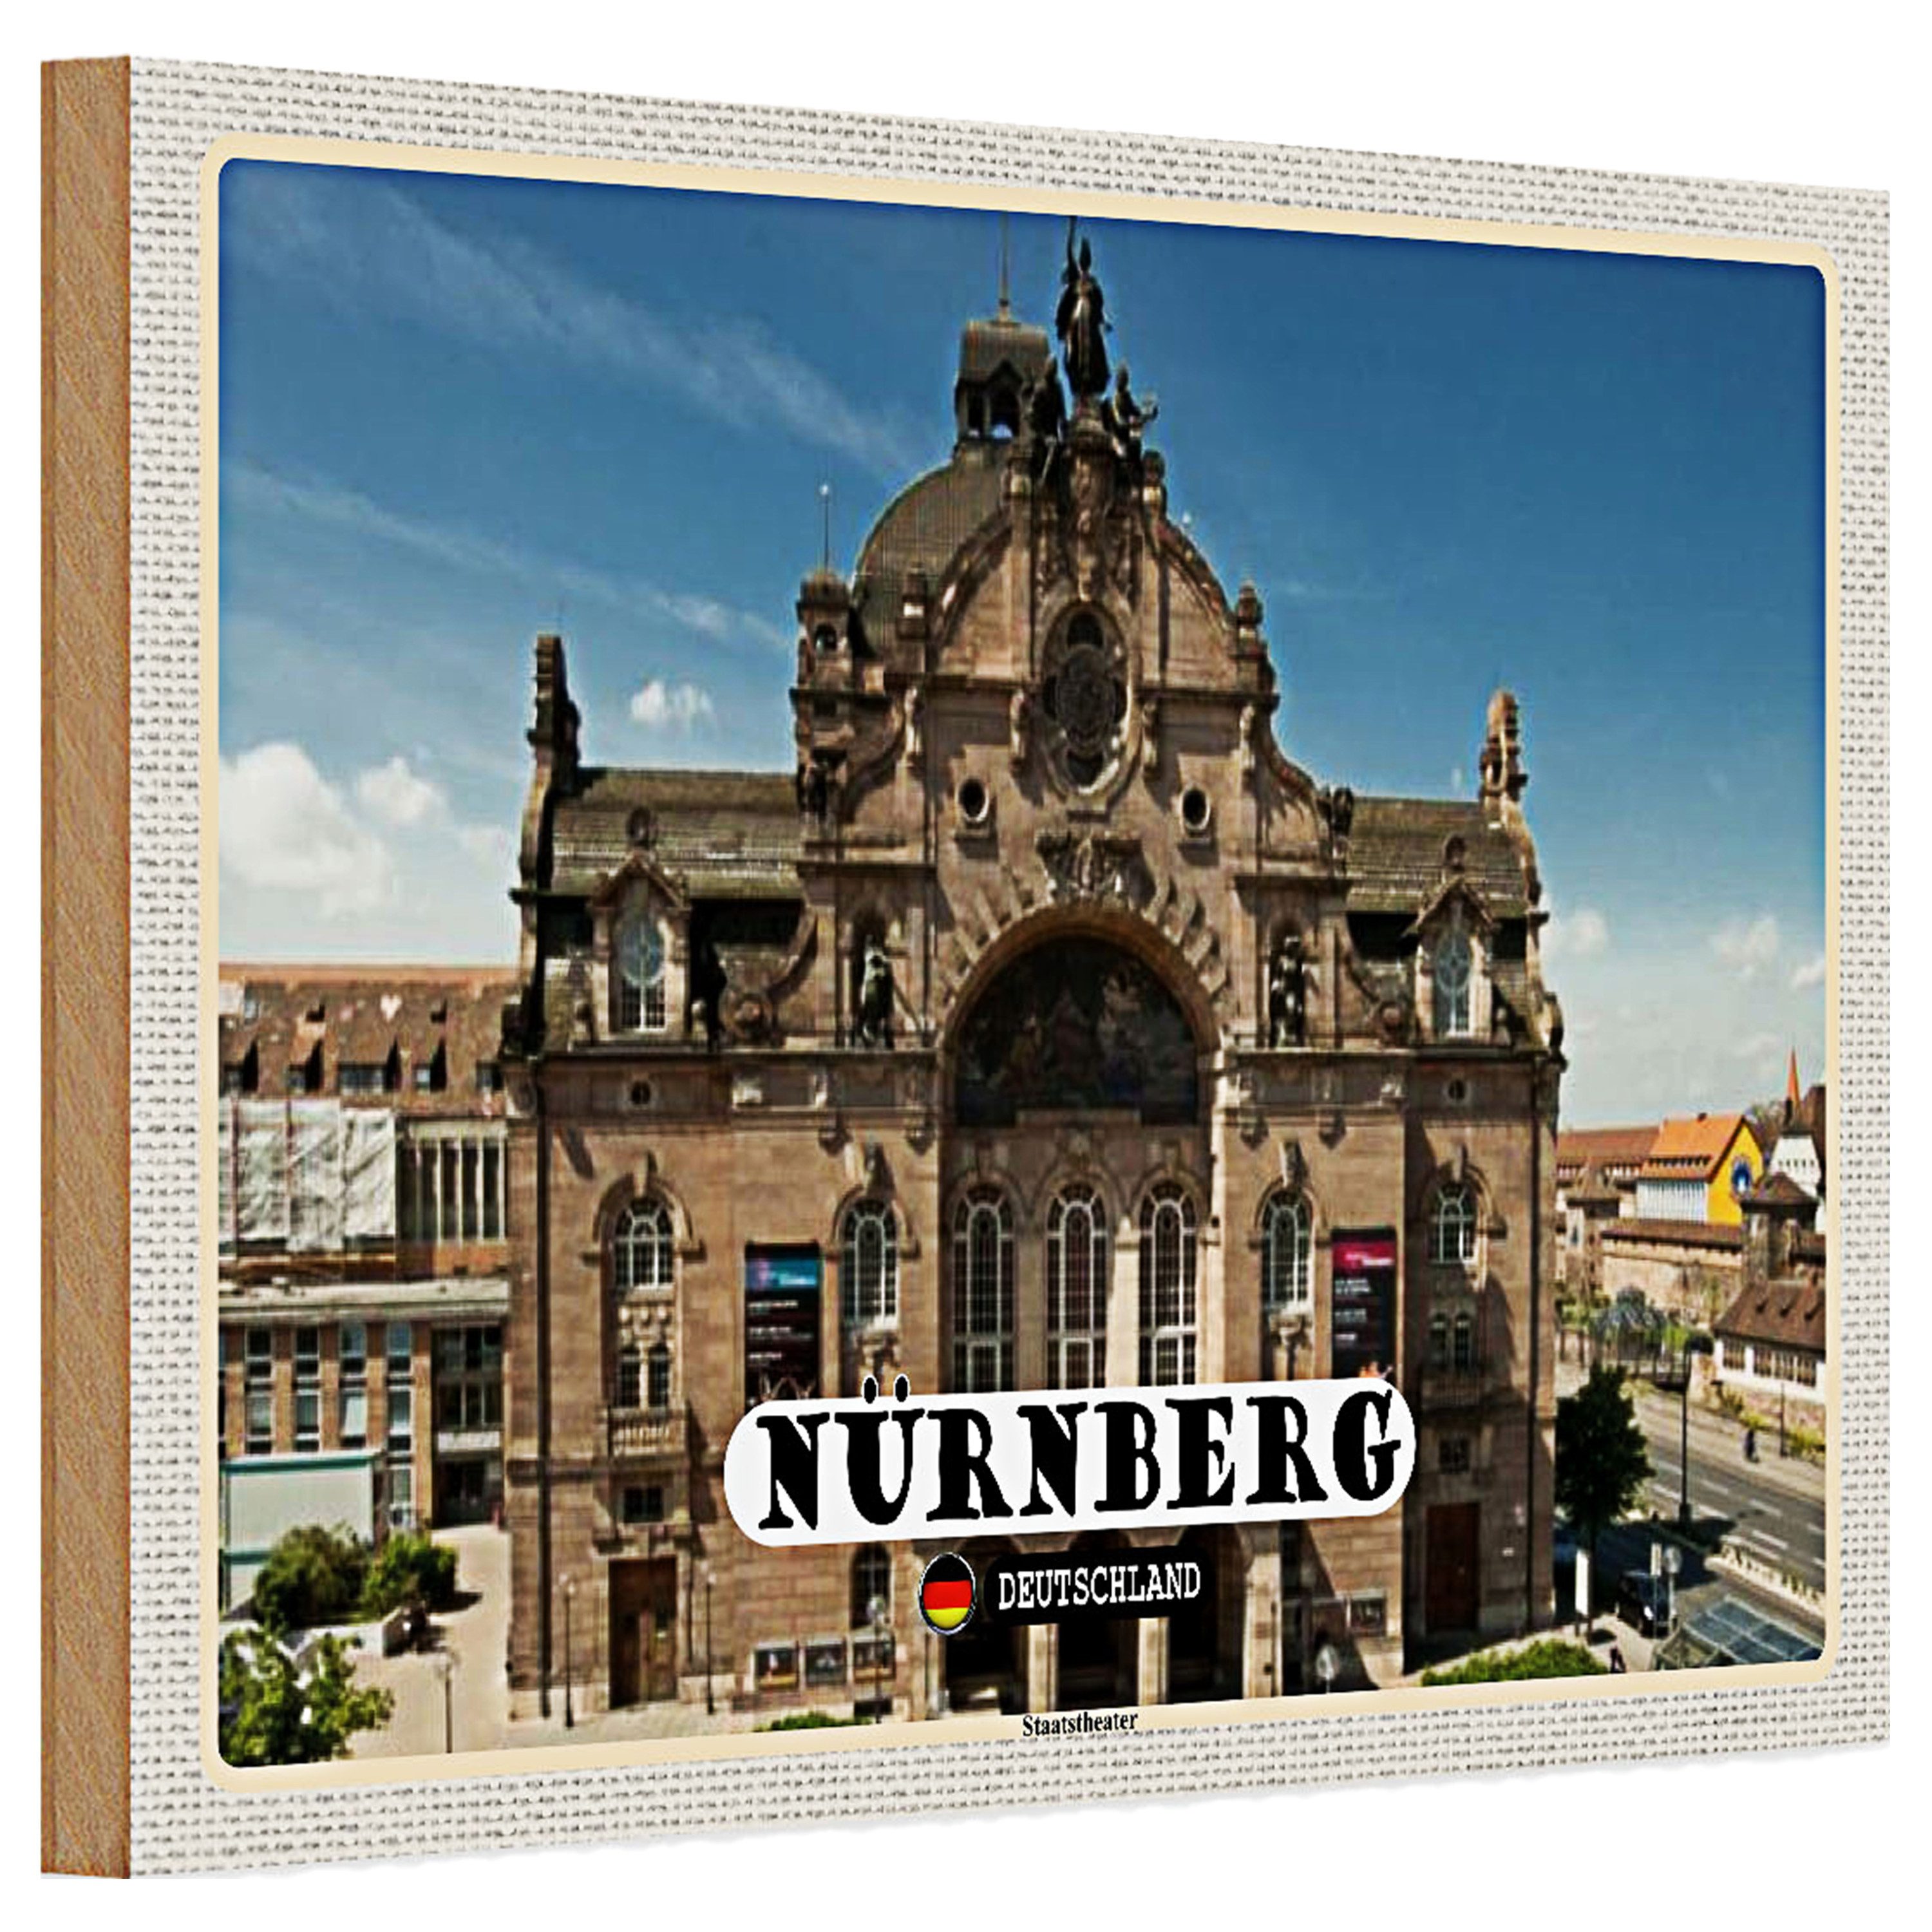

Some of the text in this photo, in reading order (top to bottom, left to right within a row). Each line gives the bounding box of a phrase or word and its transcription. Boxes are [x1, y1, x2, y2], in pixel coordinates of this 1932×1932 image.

[756, 1377, 1401, 1531] NÜRNBERG
[998, 1562, 1200, 1610] DEUTSCHLAND
[1021, 1710, 1139, 1738] Staatstheater
